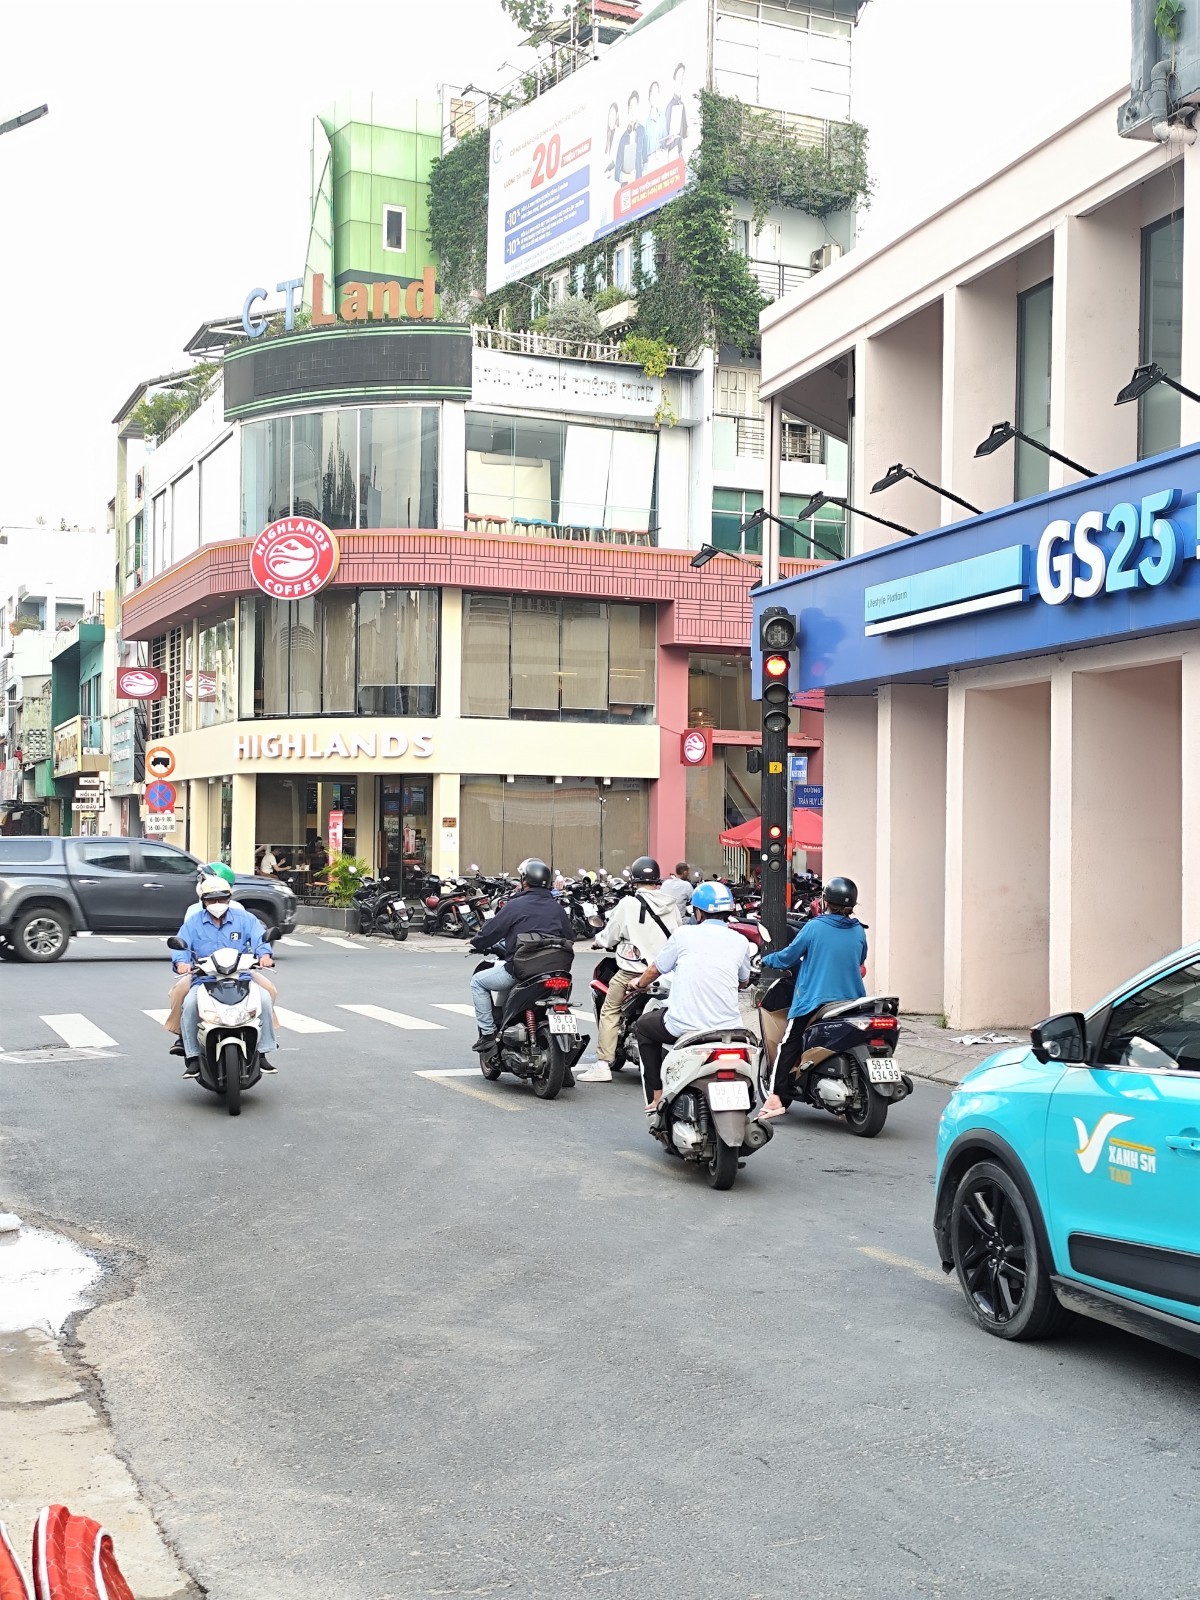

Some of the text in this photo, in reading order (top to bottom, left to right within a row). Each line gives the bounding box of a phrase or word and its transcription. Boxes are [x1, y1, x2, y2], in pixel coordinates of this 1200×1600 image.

[531, 133, 561, 190] 20
[255, 521, 330, 557] HIGHLANDS
[1036, 488, 1178, 605] GS25
[264, 573, 322, 596] COFFEE
[234, 733, 434, 759] HIGHLANDS
[1108, 1145, 1157, 1174] XANH SM
